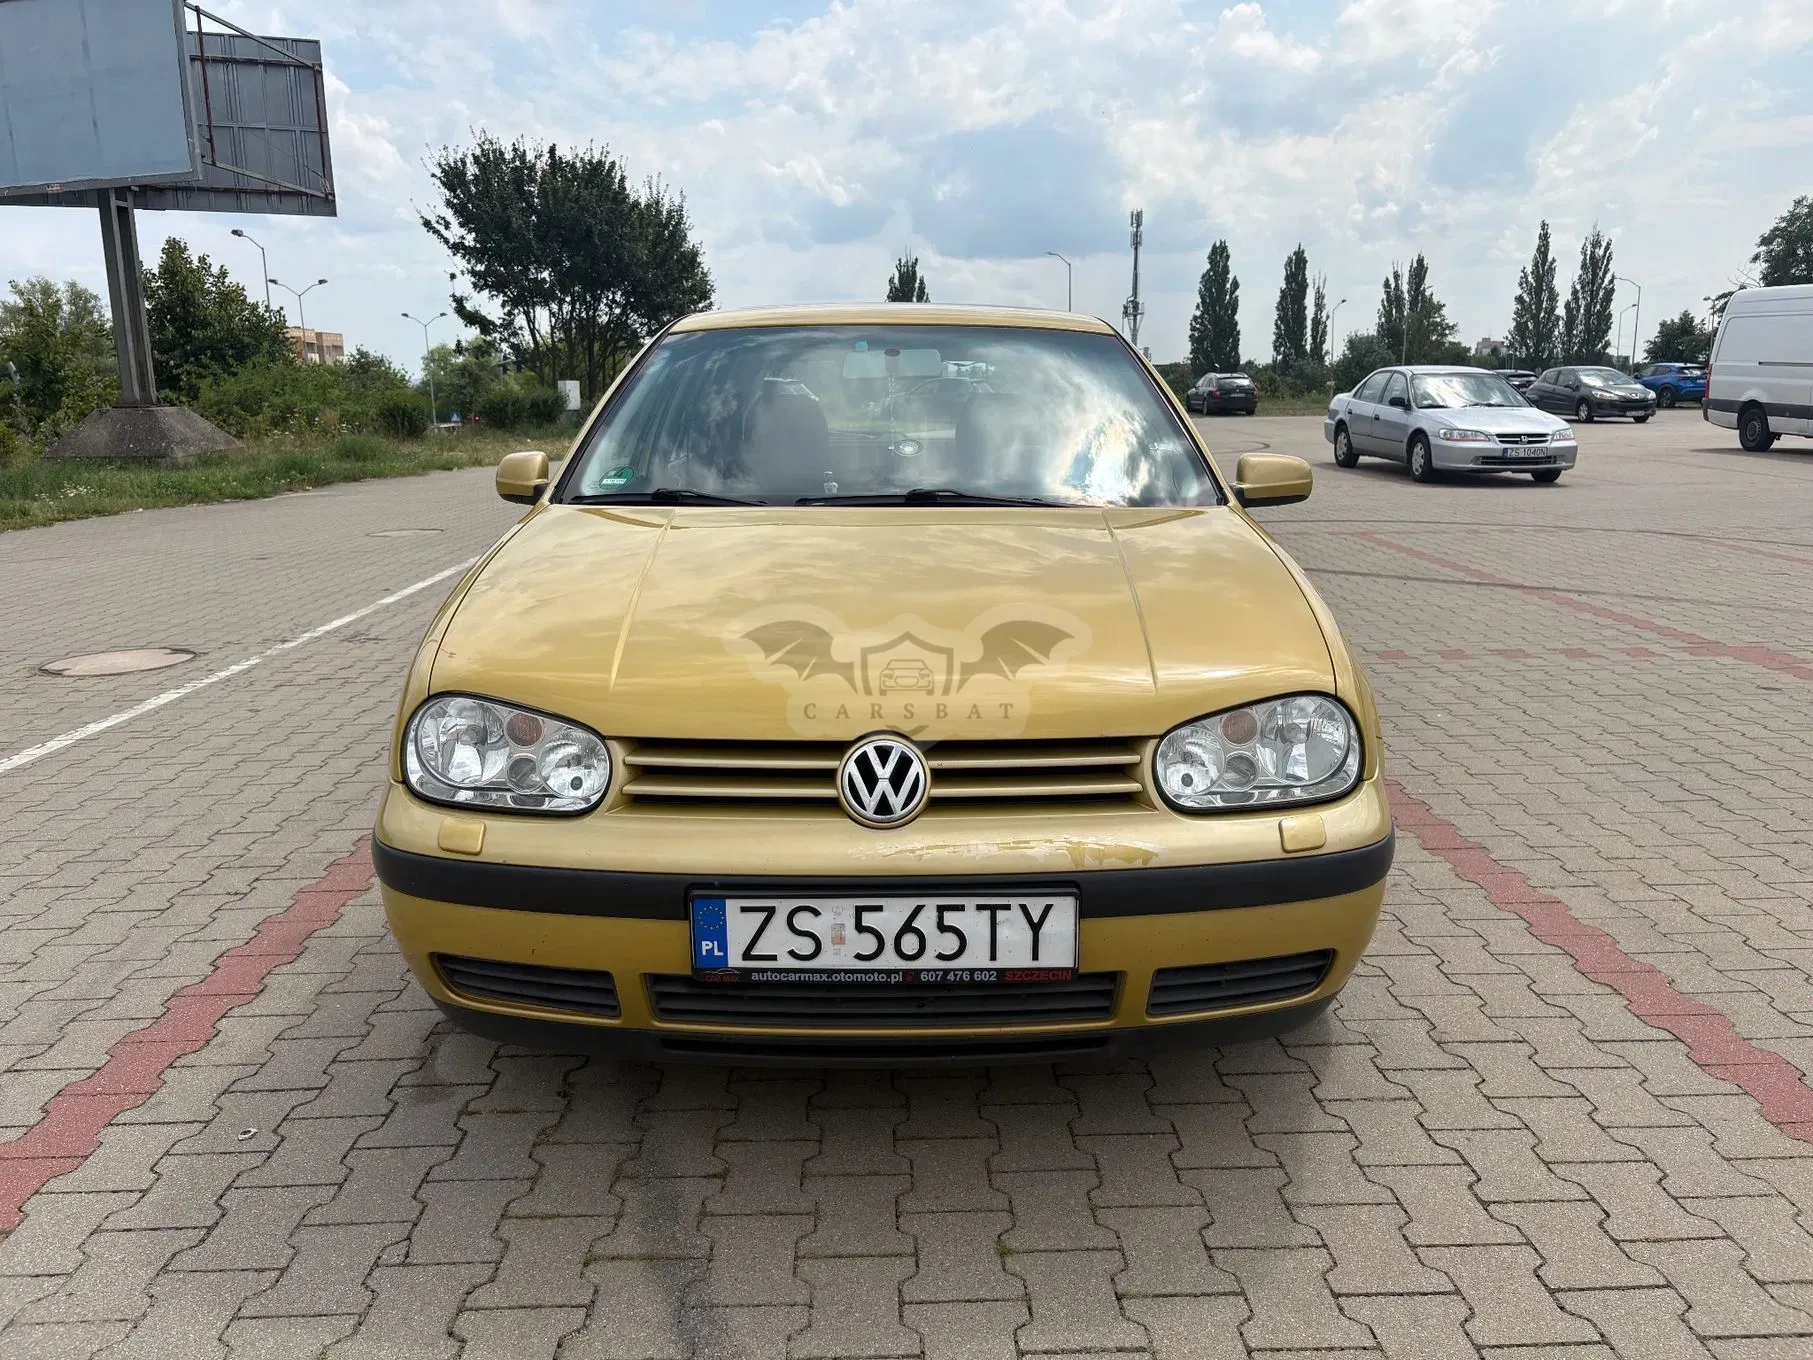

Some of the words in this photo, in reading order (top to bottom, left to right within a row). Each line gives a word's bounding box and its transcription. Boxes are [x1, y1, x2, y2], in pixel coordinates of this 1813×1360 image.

[842, 740, 925, 821] VW
[701, 940, 724, 956] PL
[740, 904, 823, 961] ZS
[853, 903, 1054, 962] 565TY
[751, 970, 903, 984] autocarmax.otomoto.pl
[920, 971, 943, 982] 607
[947, 971, 970, 982] 476
[974, 970, 997, 982] 602
[1004, 969, 1073, 982] SZCZECIN
